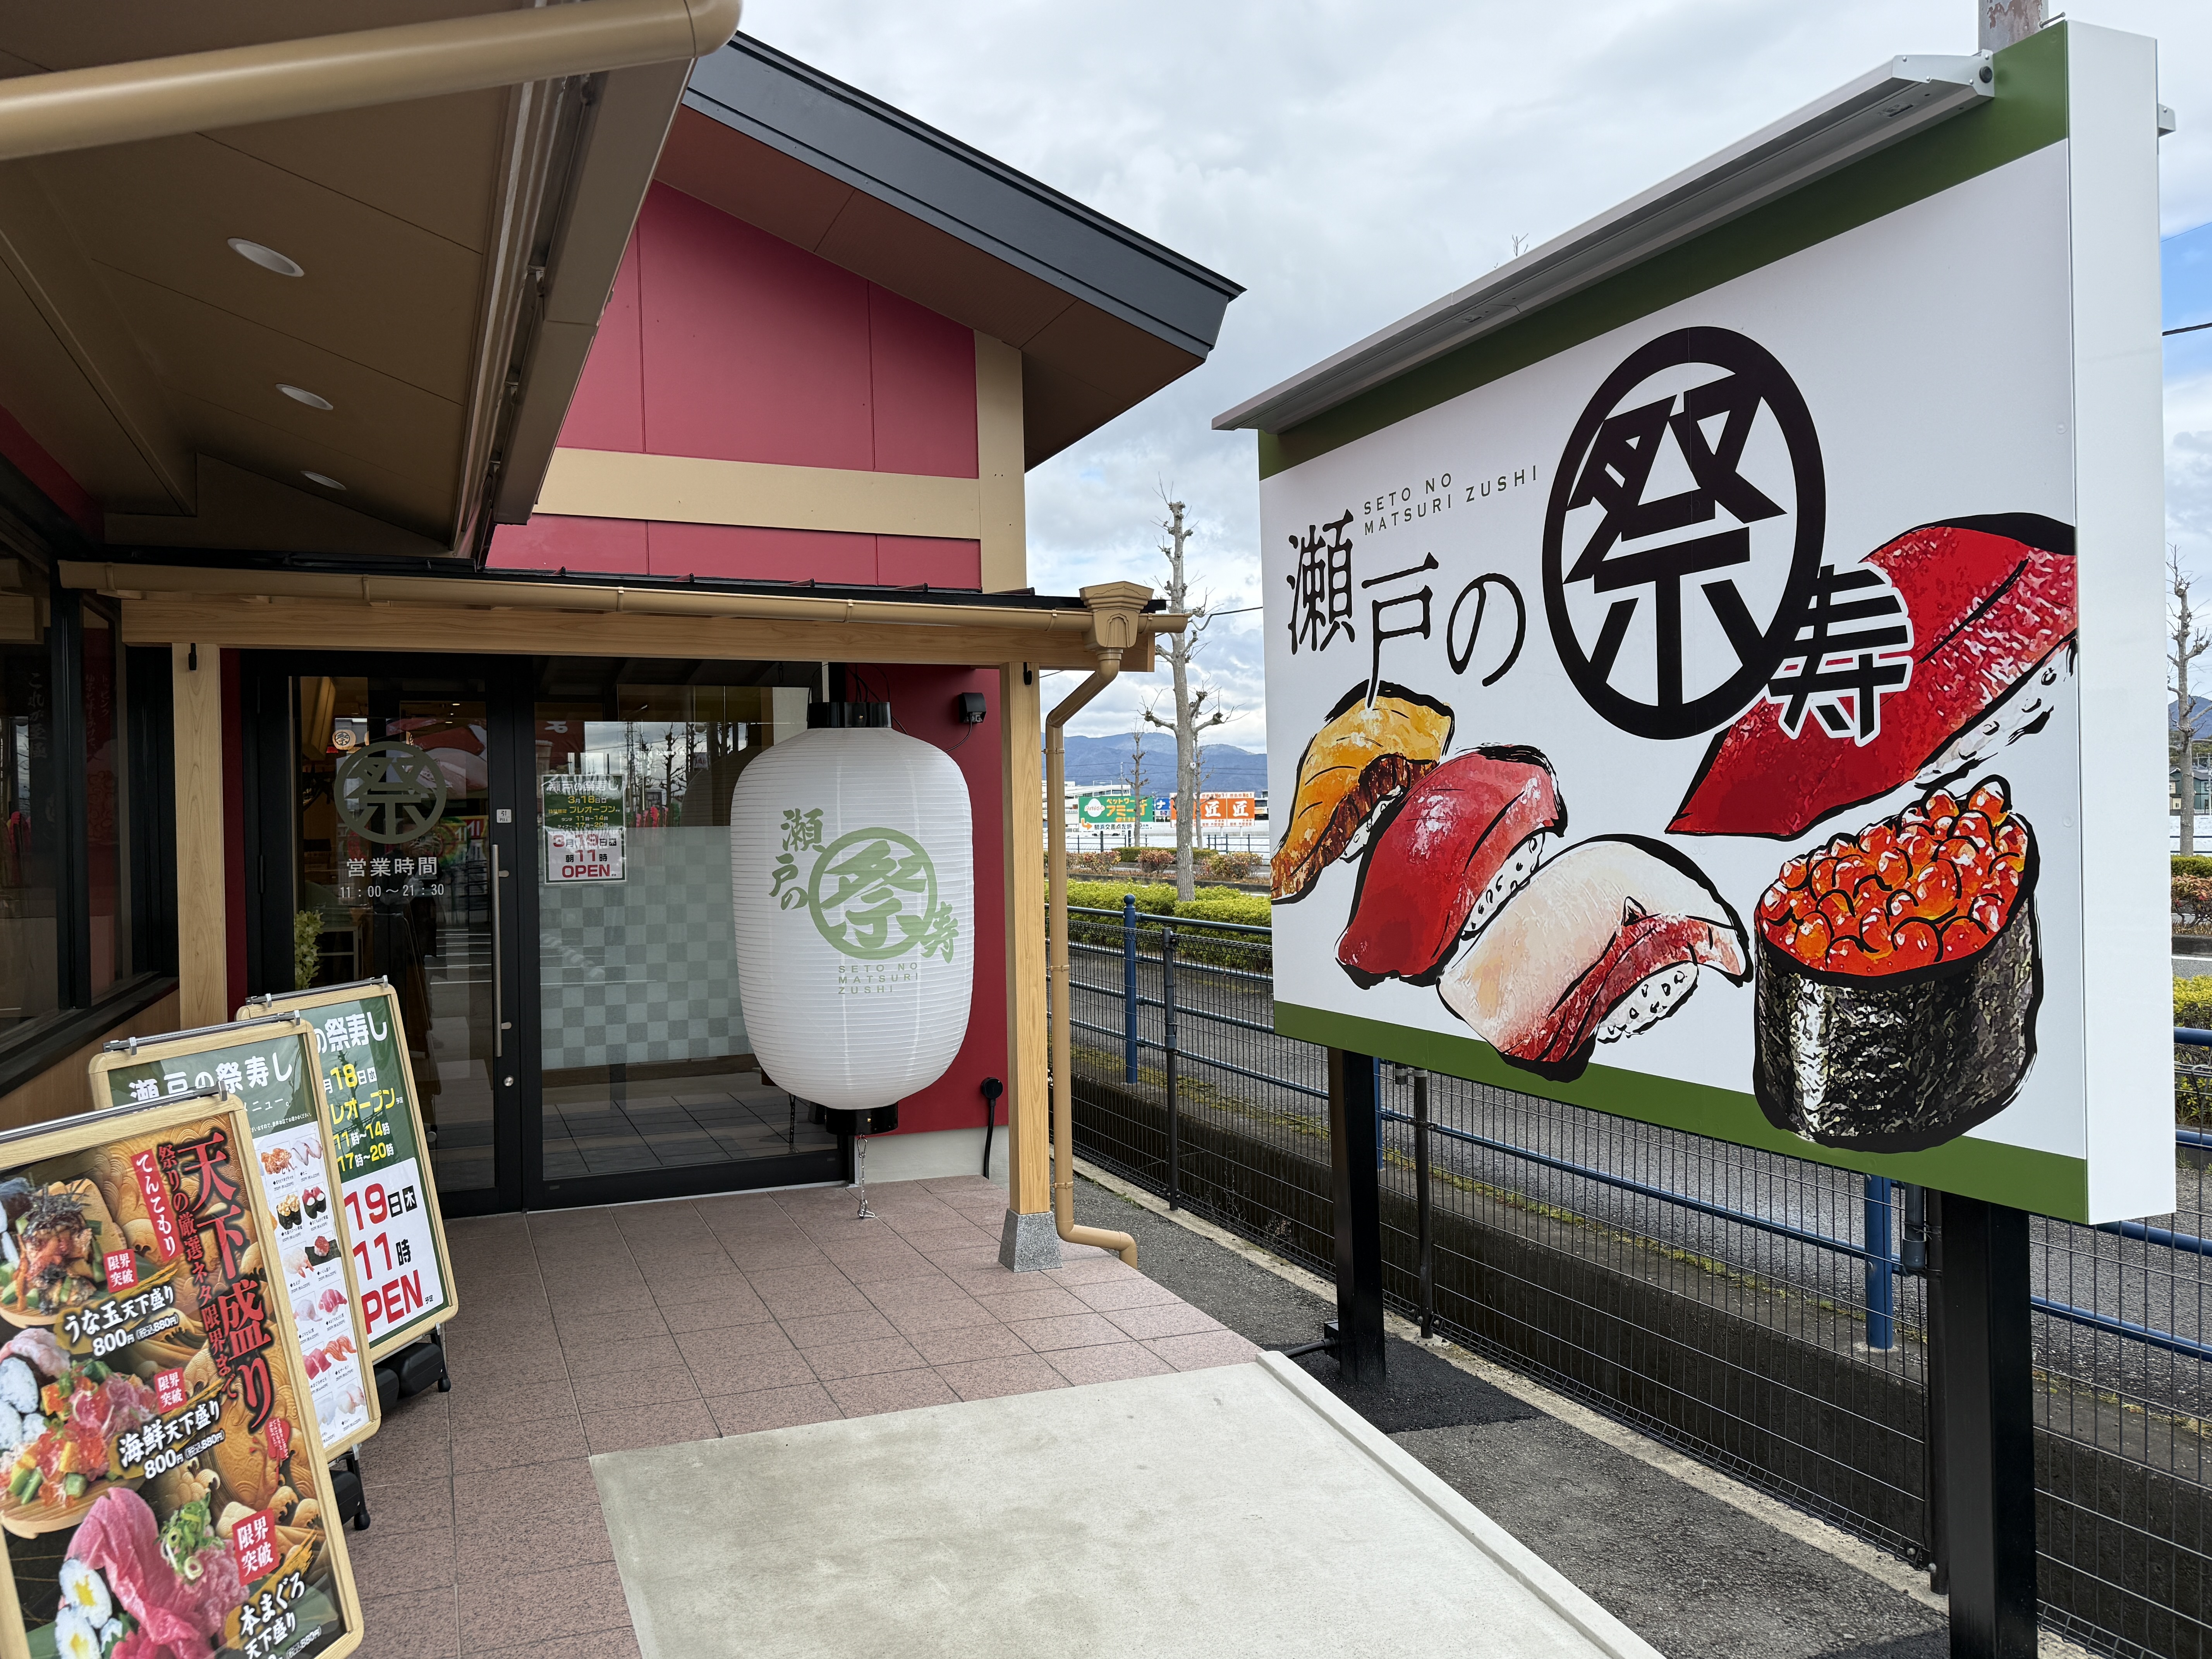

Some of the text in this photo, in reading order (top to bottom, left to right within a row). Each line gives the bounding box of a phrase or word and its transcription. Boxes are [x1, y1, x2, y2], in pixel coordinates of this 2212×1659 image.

[1364, 473, 1452, 515] SETO NO
[1365, 465, 1537, 536] MATSURI ZUSHI
[334, 741, 446, 844] 祭
[1205, 800, 1221, 817] 匠
[1233, 800, 1249, 817] 匠
[347, 857, 437, 877] 営業時間
[562, 864, 610, 878] OPEN
[565, 849, 608, 862] 朝11時
[839, 962, 918, 973] SETO NO
[839, 972, 918, 984] MATSURI
[838, 986, 893, 994] ZUSHI
[159, 1144, 237, 1397] 祭りの厳選ネタ限界まで
[353, 1232, 412, 1280] 11時
[177, 1132, 271, 1428] 天下盛り
[65, 1286, 173, 1343] うな玉天下盛り
[119, 1400, 219, 1468] 海鮮天下盛り
[240, 1572, 305, 1636] 本まぐろ
[244, 1612, 295, 1659] 天下盛り
